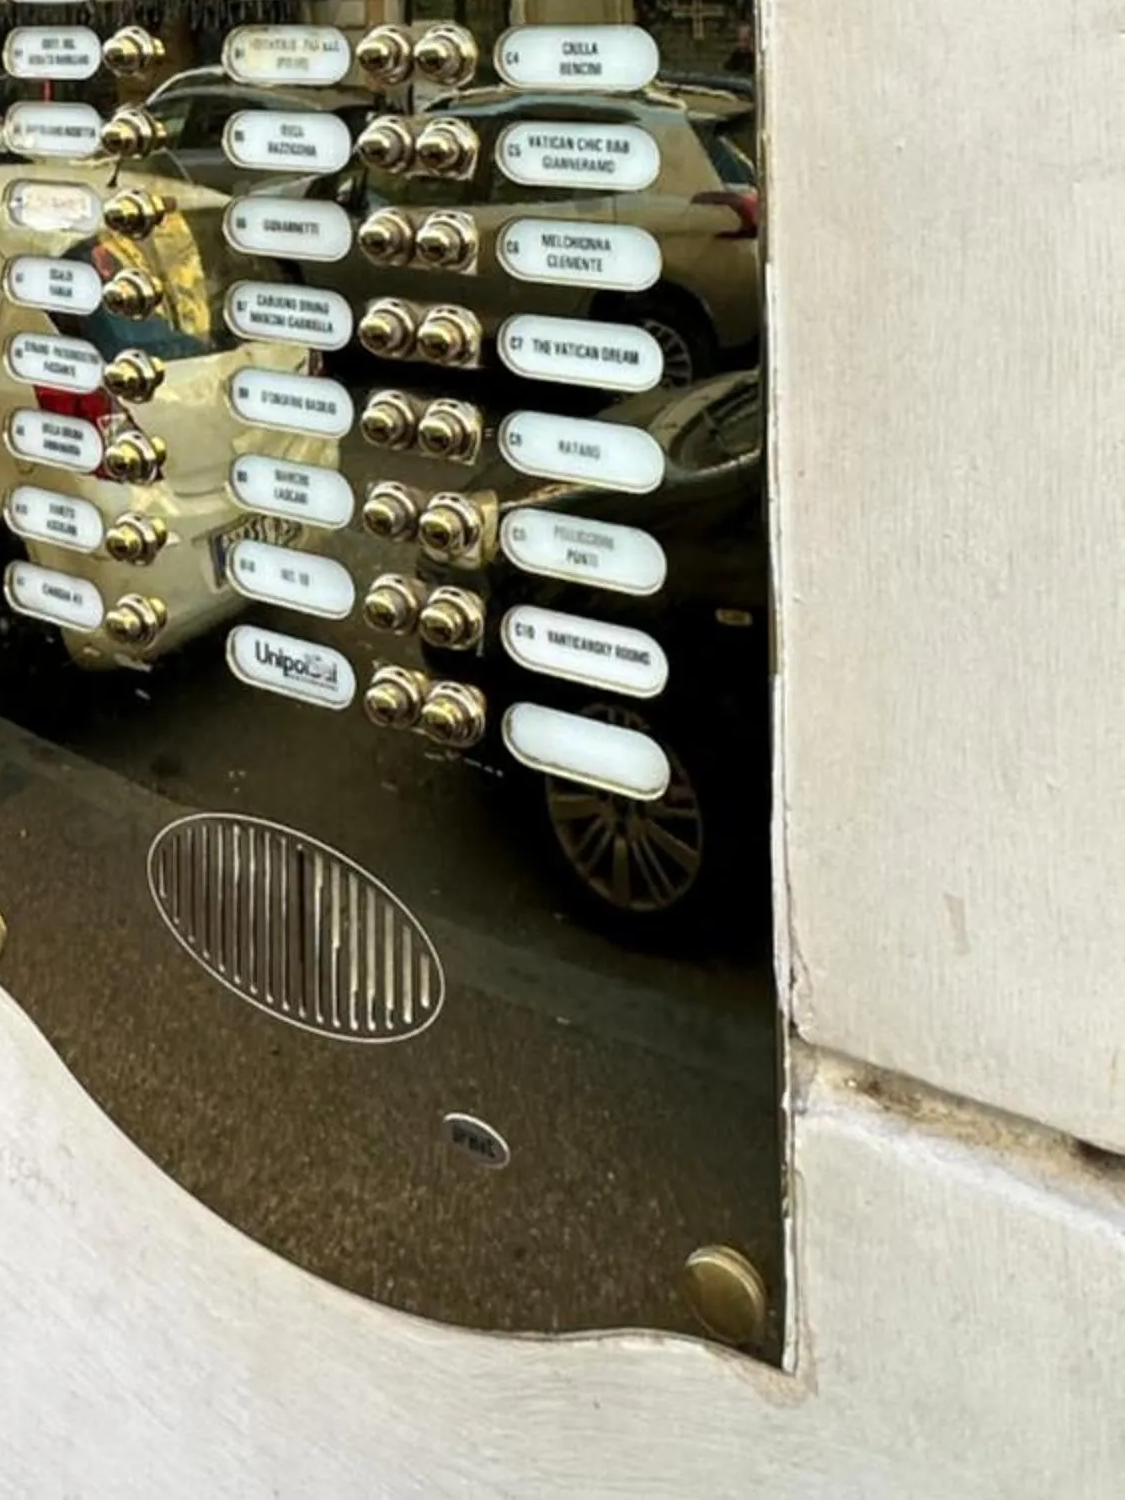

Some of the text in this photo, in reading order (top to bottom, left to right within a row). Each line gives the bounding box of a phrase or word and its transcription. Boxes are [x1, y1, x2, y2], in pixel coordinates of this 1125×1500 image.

[527, 135, 573, 151] VATICAN
[546, 254, 604, 273] CLEMENTE
[531, 338, 551, 356] THE
[553, 341, 600, 361] VATICAN
[601, 346, 640, 366] DREAM
